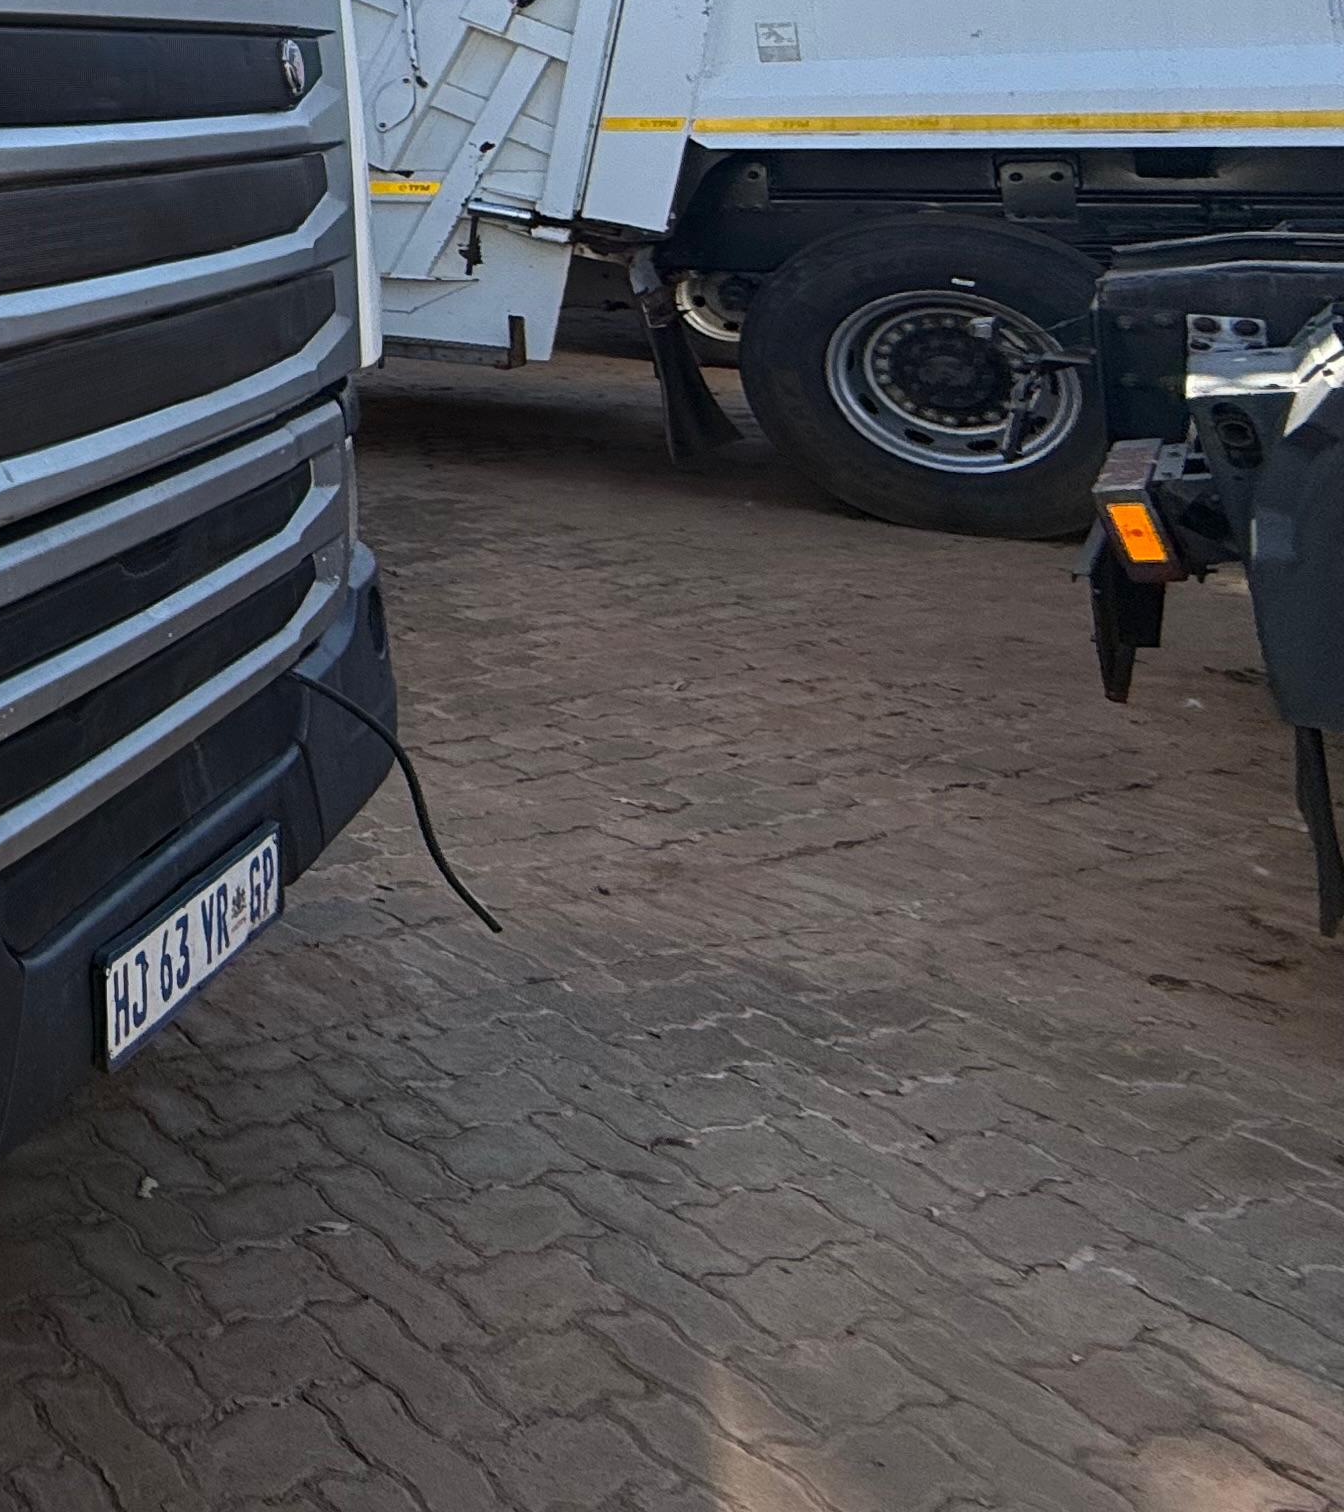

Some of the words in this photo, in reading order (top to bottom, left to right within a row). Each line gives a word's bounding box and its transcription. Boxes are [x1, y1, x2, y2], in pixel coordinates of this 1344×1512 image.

[113, 950, 149, 1046] HJ
[159, 915, 191, 1003] 63
[200, 882, 230, 965] YR
[249, 847, 274, 925] GP
